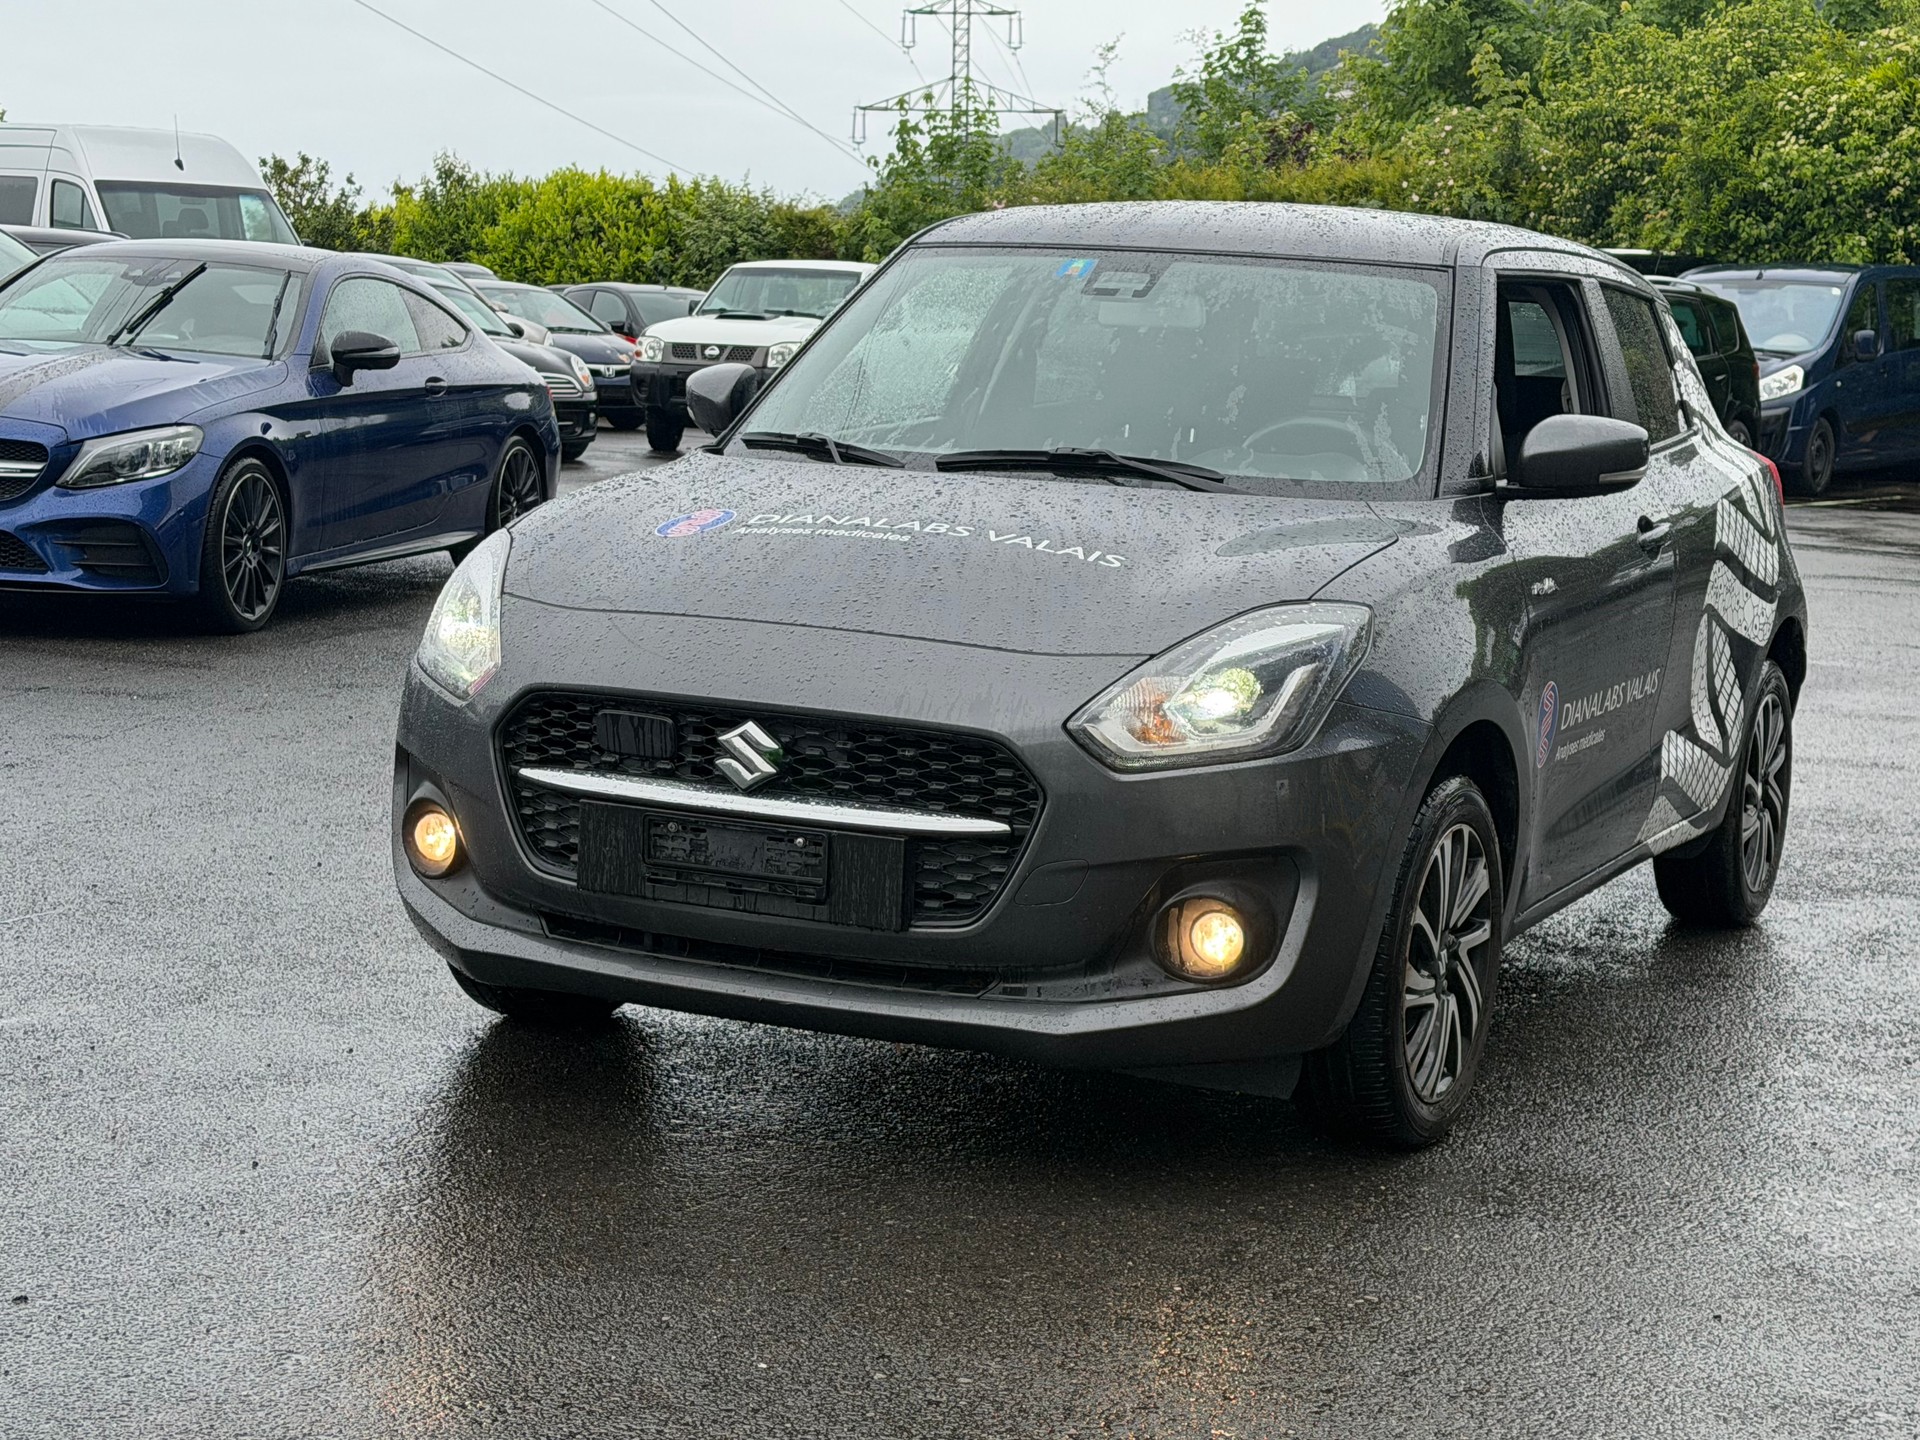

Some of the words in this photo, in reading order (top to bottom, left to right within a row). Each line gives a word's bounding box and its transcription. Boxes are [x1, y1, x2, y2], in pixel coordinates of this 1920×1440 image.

[731, 526, 814, 536] Analyses
[748, 514, 975, 537] DIANALABS
[989, 530, 1126, 567] VALAIS
[1561, 682, 1626, 730] DIANALABS
[1627, 668, 1661, 704] VALAIS
[1555, 740, 1580, 762] Analyses
